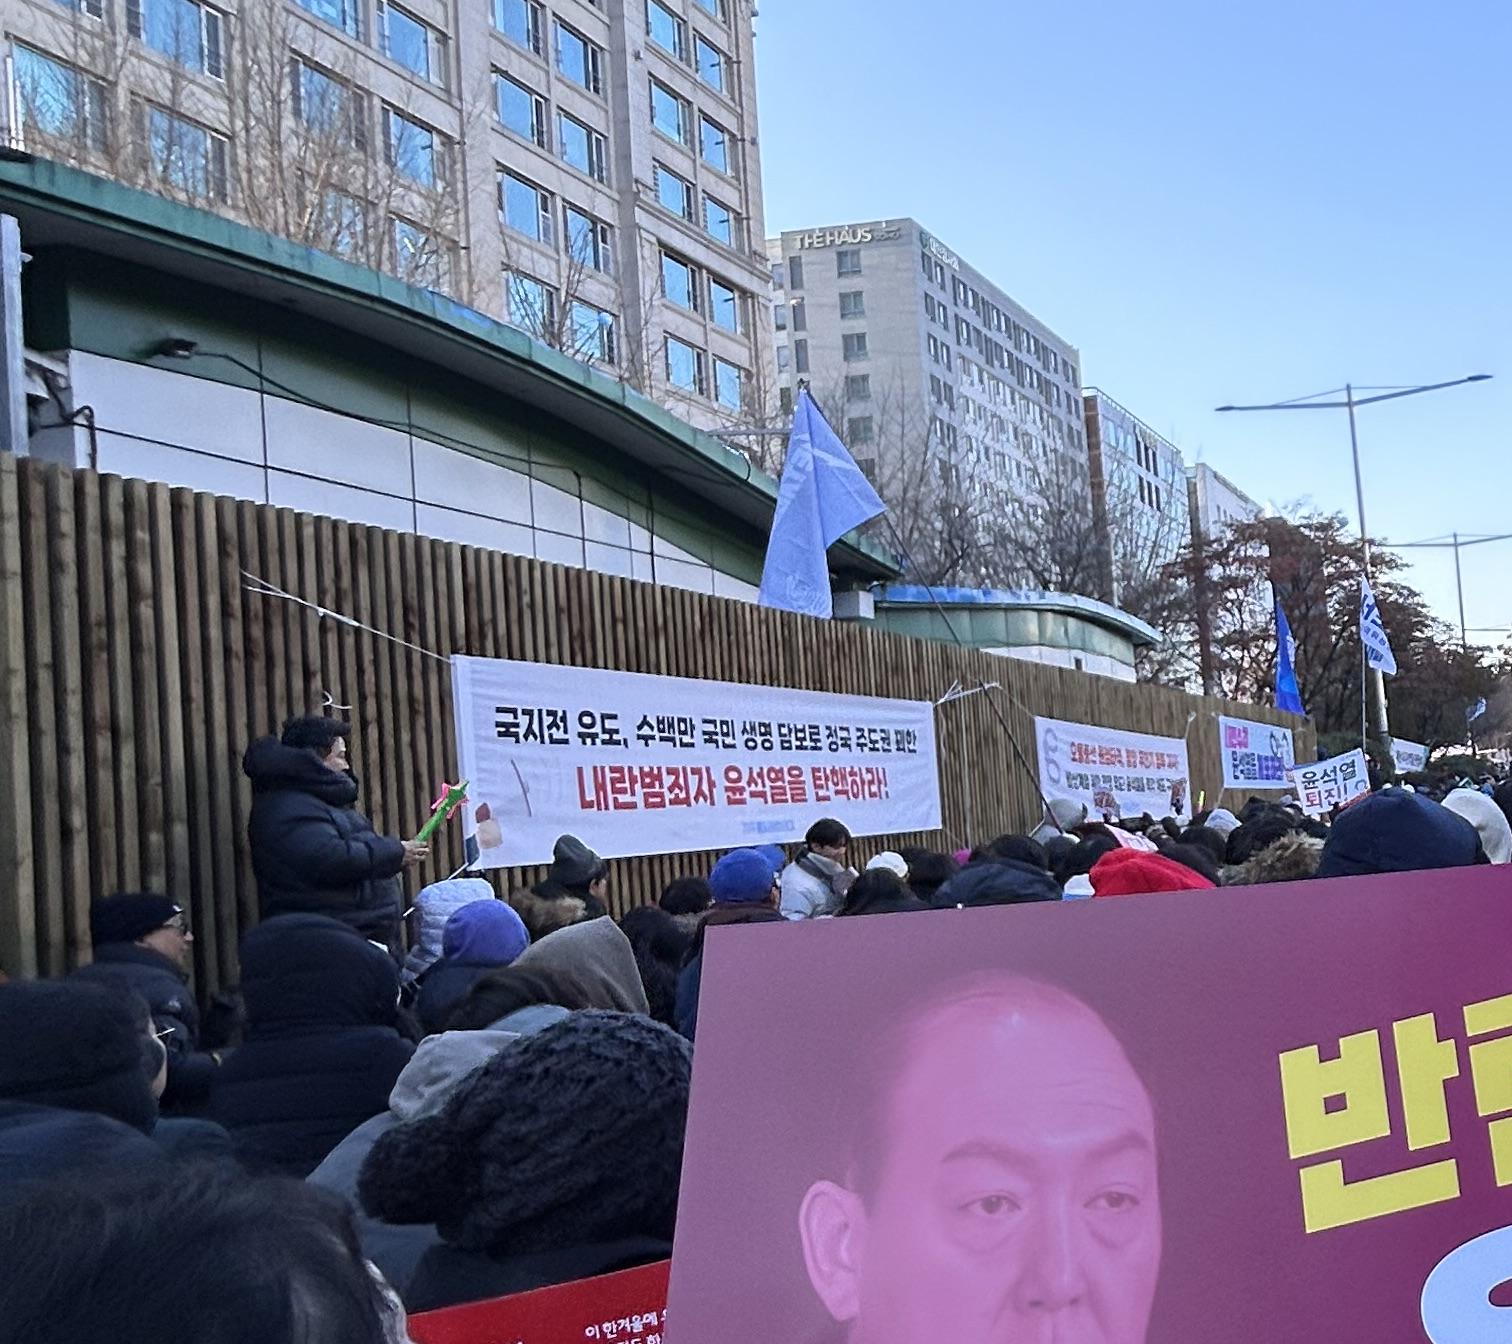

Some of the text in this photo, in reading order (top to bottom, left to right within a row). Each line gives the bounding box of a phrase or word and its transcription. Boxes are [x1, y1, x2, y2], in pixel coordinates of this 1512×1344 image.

[494, 705, 570, 745] 국지전
[577, 709, 629, 748] 유도,
[636, 713, 696, 749] 수백만
[701, 718, 737, 750] 국민
[741, 720, 774, 751] 생명
[777, 722, 823, 752] 담보로
[825, 725, 852, 753] 정국
[855, 726, 892, 754] 주도권
[576, 764, 890, 812] 내란범죄자 윤석열을 탄핵하라!
[1302, 758, 1357, 790] 윤석열
[1305, 782, 1348, 809] 퇴진!
[585, 1324, 600, 1340] 이
